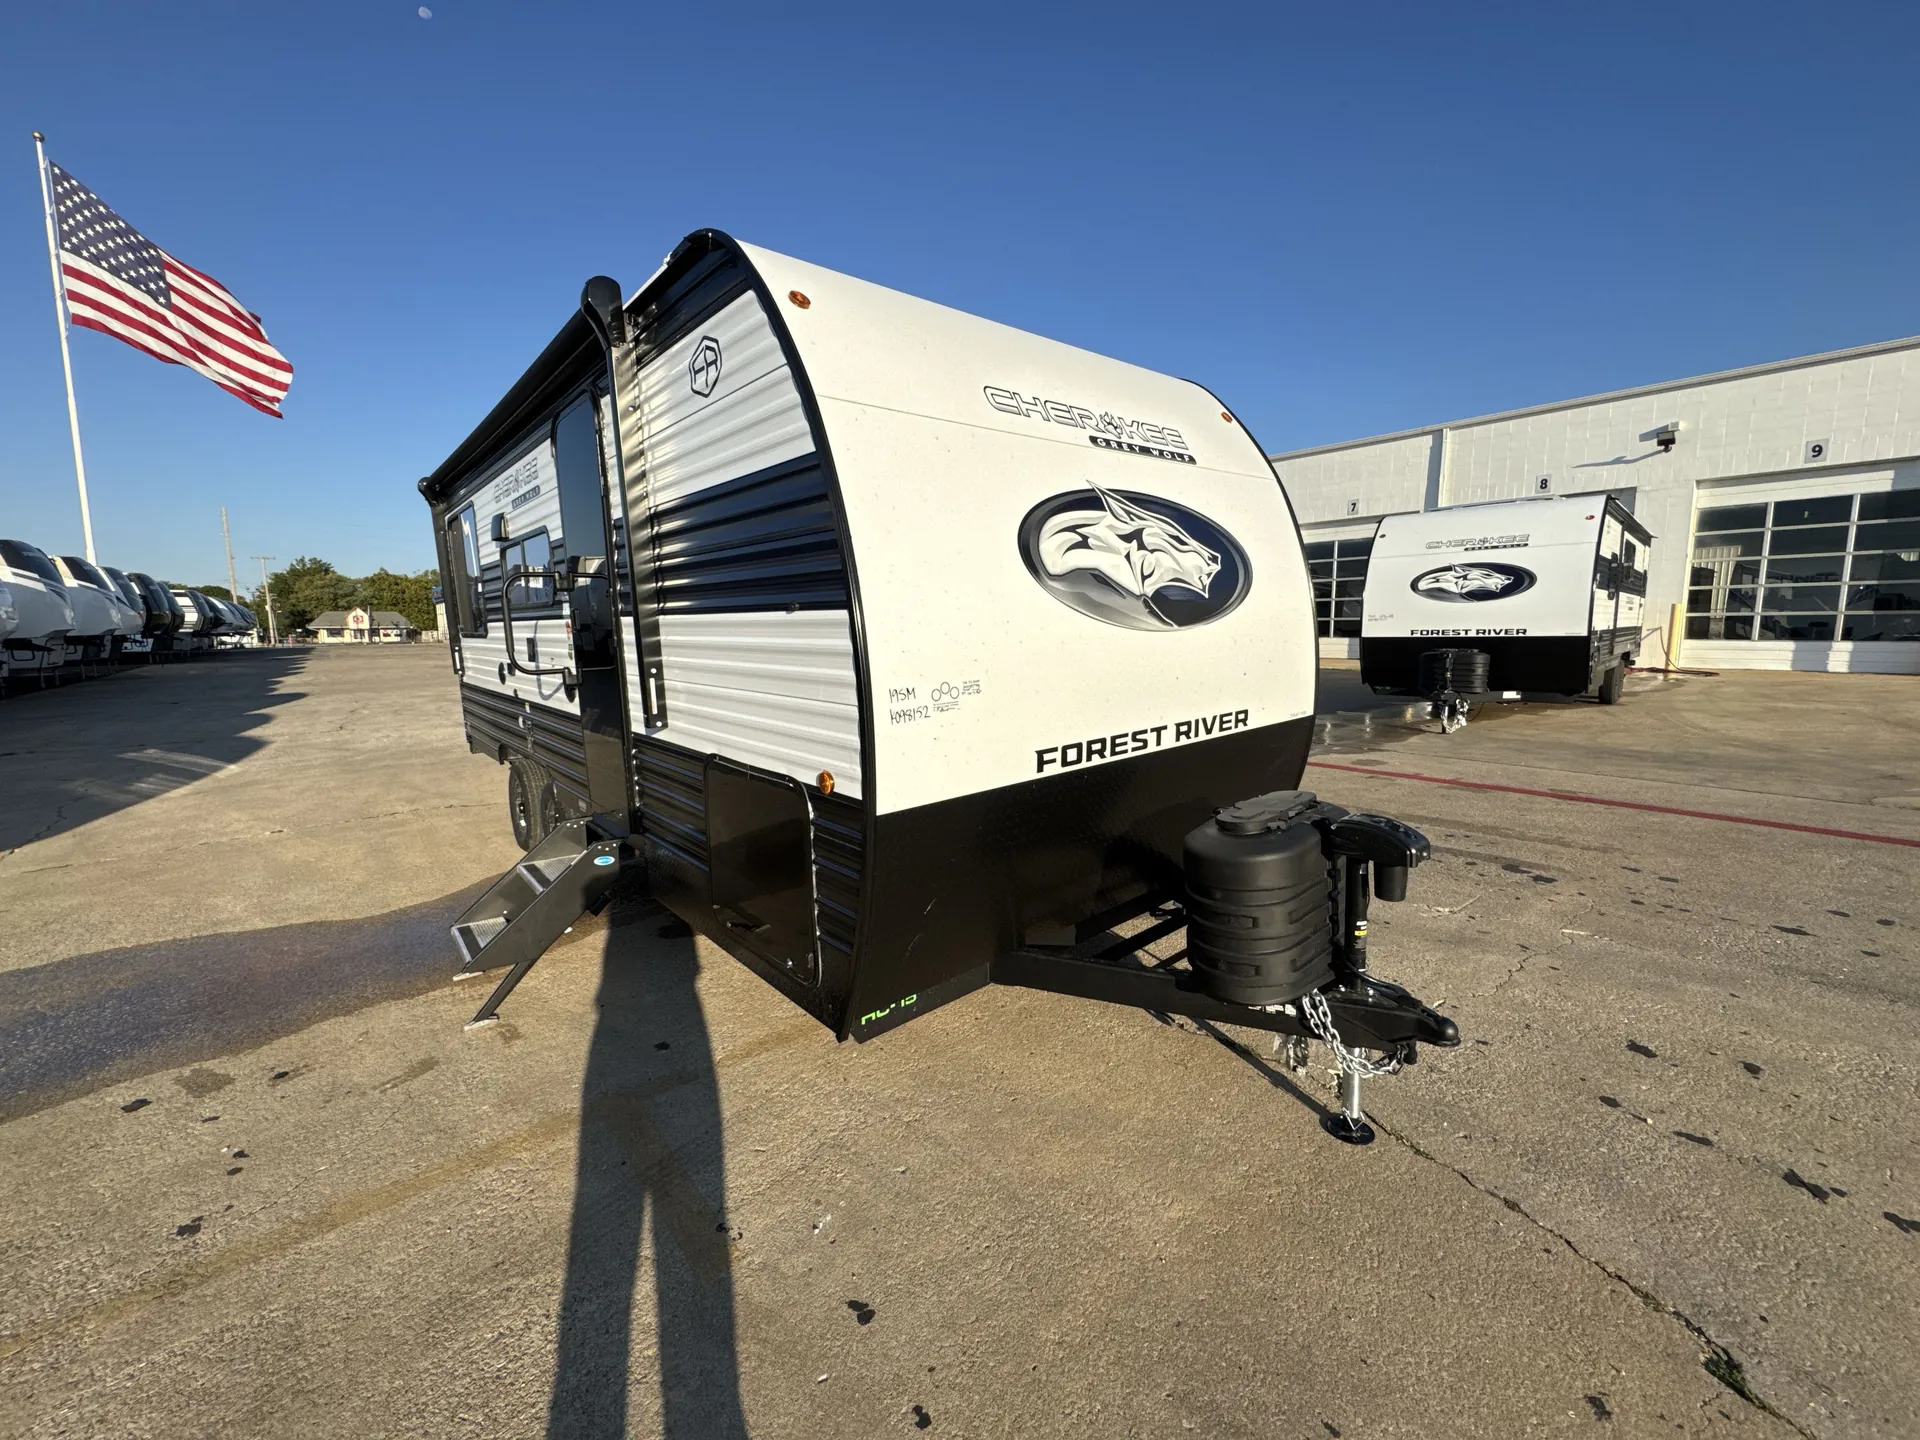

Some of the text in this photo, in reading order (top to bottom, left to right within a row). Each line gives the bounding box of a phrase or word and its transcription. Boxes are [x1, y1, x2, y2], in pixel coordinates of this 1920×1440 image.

[983, 385, 1189, 450] CHEROKEE
[1096, 438, 1191, 462] GREY WOLF
[1811, 444, 1823, 458] 9
[1539, 478, 1548, 490] 8
[1351, 502, 1357, 512] 7
[1476, 628, 1528, 636] RIVER
[1034, 709, 1249, 774] FOREST RIVER
